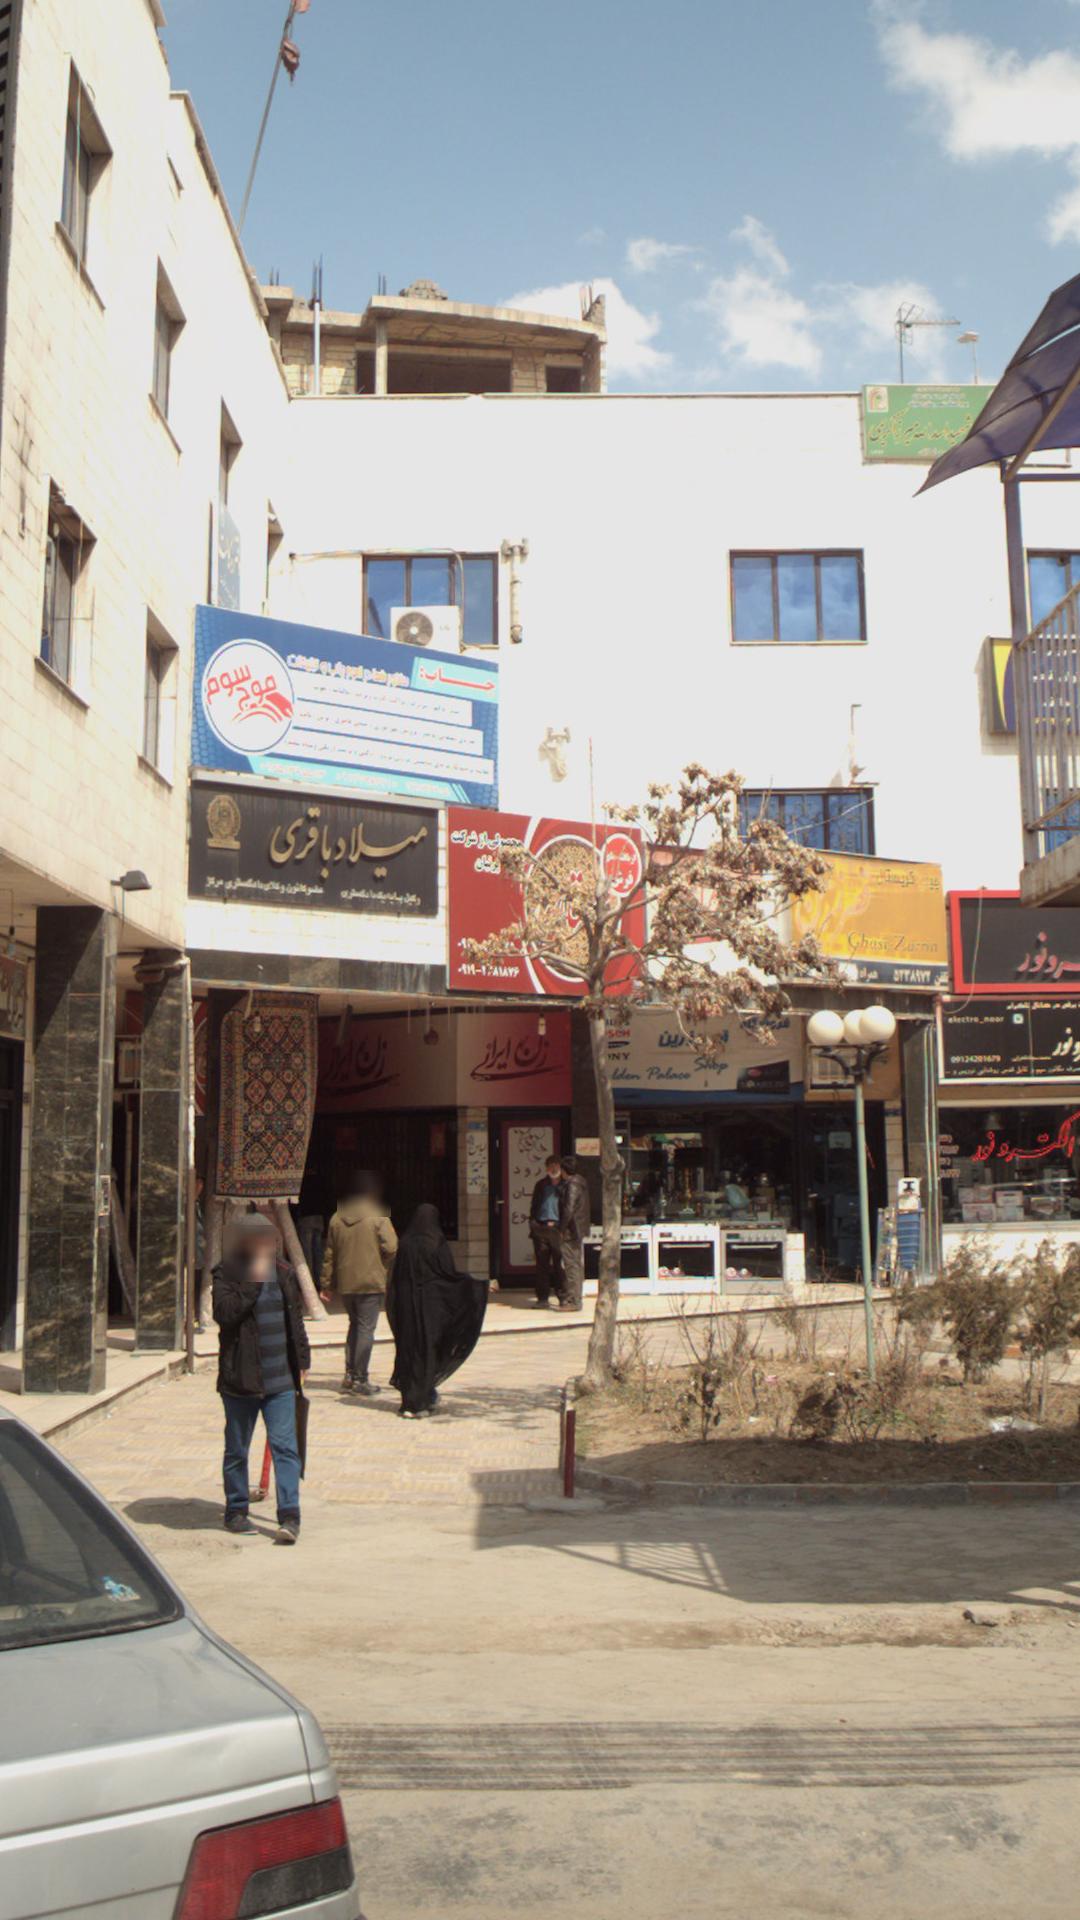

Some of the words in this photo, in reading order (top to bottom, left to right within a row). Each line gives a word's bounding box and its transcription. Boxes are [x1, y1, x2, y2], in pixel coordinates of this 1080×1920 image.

[206, 665, 252, 705] سوم
[237, 673, 277, 711] موج
[269, 807, 332, 880] باقری
[334, 822, 428, 878] میلاد
